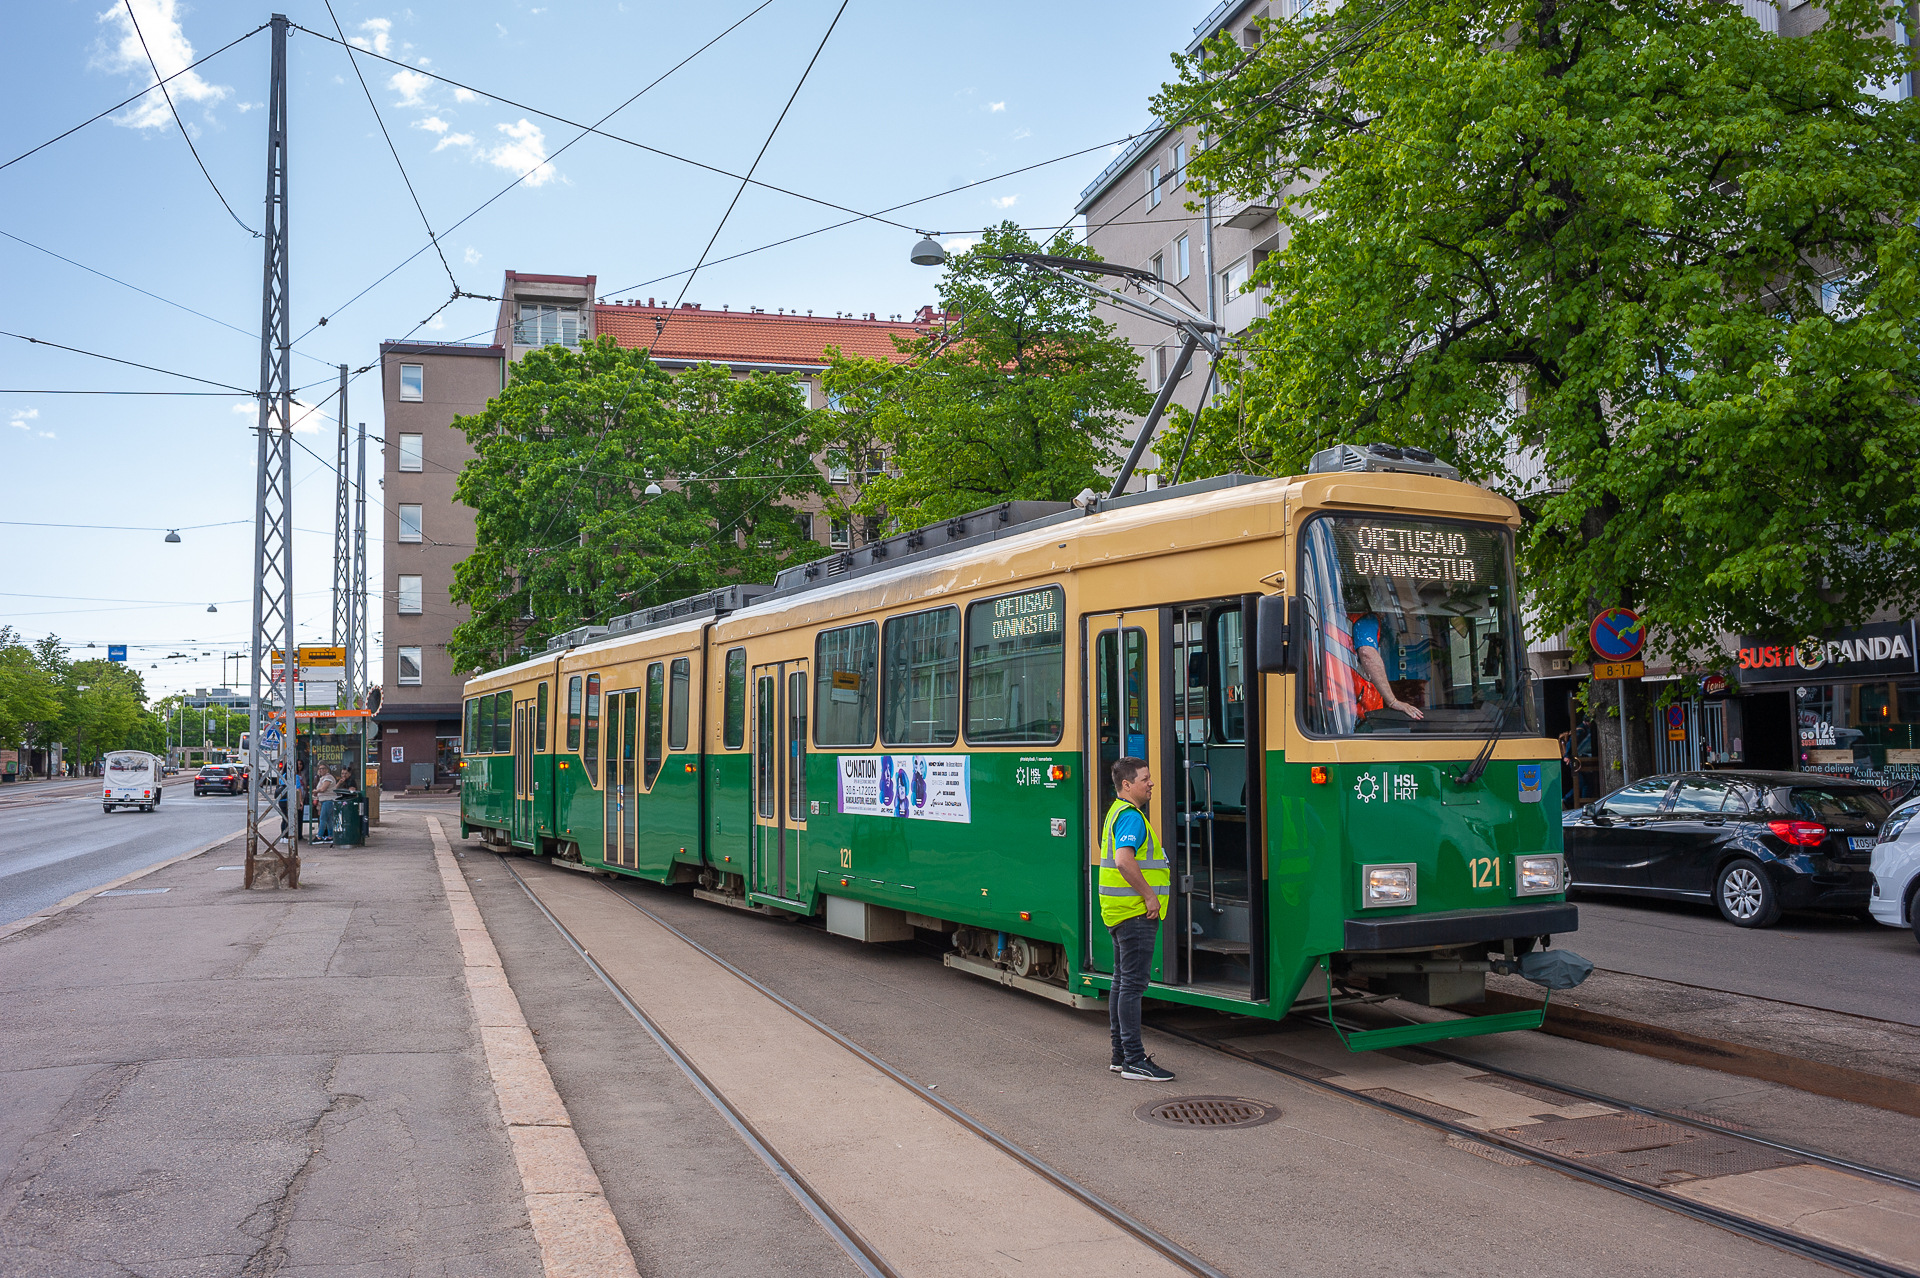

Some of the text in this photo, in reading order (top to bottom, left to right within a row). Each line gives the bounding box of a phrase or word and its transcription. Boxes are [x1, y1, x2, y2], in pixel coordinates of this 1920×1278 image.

[1357, 526, 1467, 556] OPETUSAJO
[994, 590, 1053, 618] OPETUSAJO
[1827, 634, 1913, 664] PANDA
[317, 752, 343, 761] PEKONI
[1824, 763, 1859, 775] delivery
[1856, 767, 1881, 778] coffee
[1393, 774, 1418, 787] HSL
[1393, 787, 1419, 800] HRT
[840, 848, 852, 869] 121
[1469, 856, 1501, 888] 121
